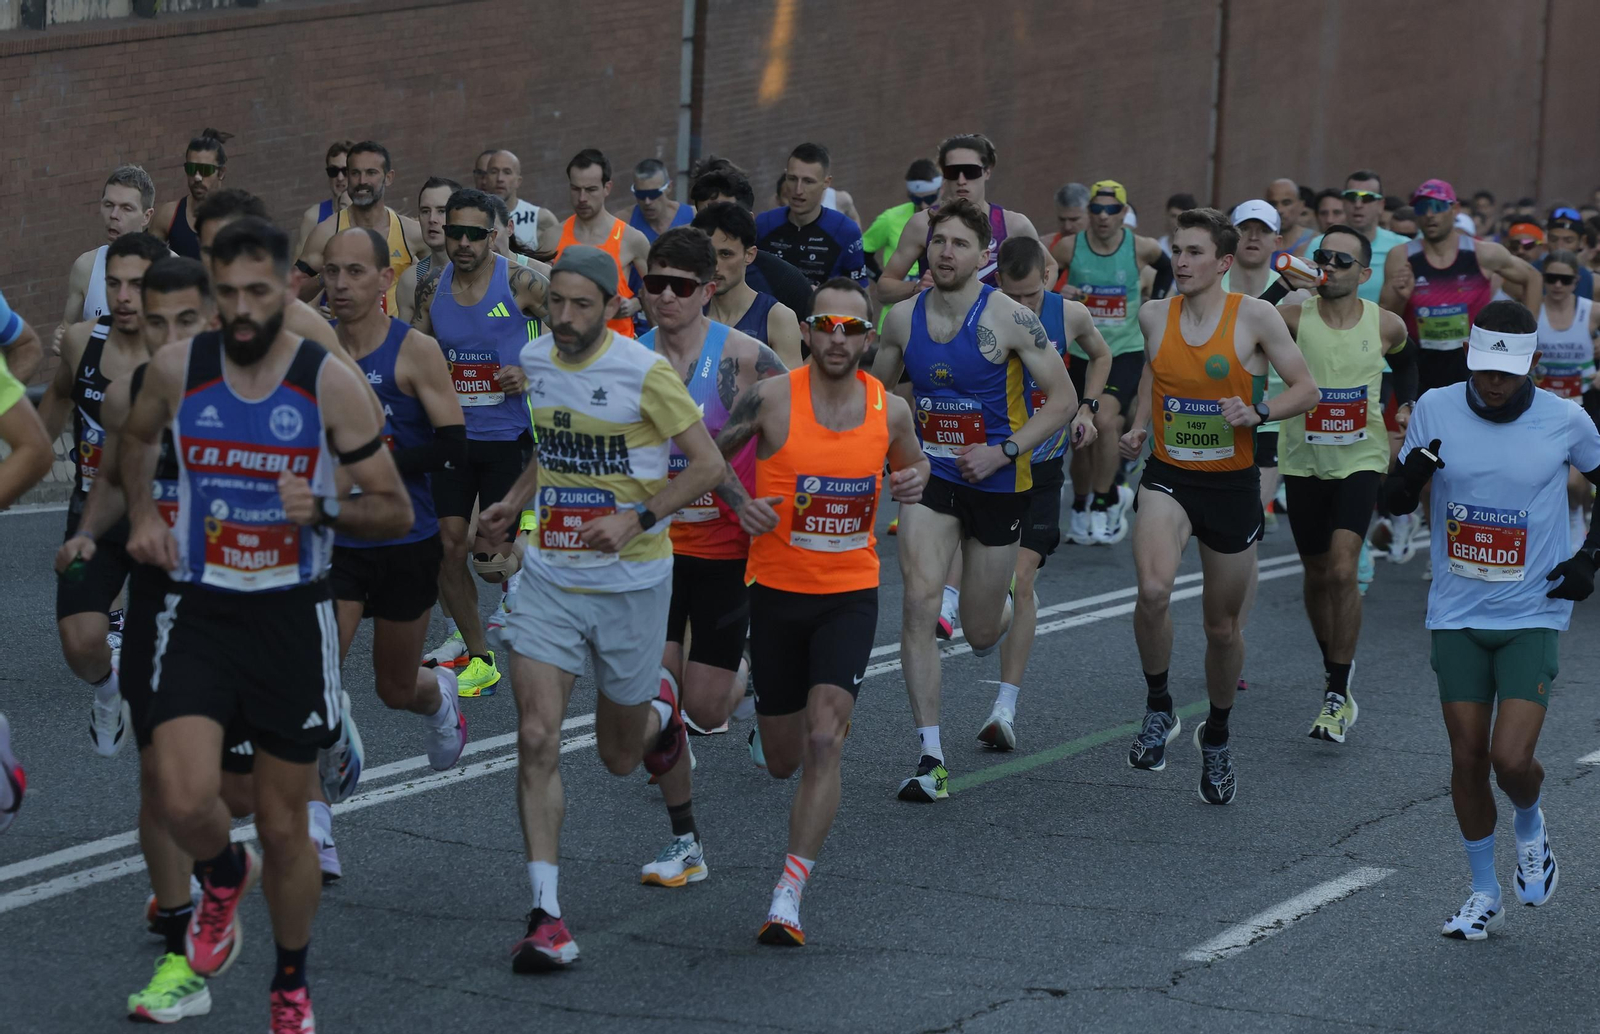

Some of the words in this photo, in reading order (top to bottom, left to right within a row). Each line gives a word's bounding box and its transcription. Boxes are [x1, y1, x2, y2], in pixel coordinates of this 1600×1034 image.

[1431, 306, 1462, 315] ZURICH
[459, 353, 492, 361] ZURICH
[463, 369, 477, 378] 692
[701, 356, 713, 379] soar
[455, 379, 492, 392] COHEN
[1326, 391, 1362, 400] ZURICH
[936, 402, 973, 411] ZURICH
[1184, 403, 1223, 412] ZURICH
[1329, 408, 1346, 417] 929
[553, 410, 571, 429] 59
[938, 419, 959, 429] 1219
[1186, 421, 1207, 430] 1497
[1321, 418, 1354, 431] RICHI
[936, 430, 965, 445] EOIN
[1176, 432, 1220, 446] SPOOR
[667, 459, 690, 468] URI
[826, 481, 870, 492] ZURICH
[559, 492, 605, 504] ZURICH
[825, 503, 849, 515] 1061
[232, 508, 286, 523] ZURICH
[563, 516, 582, 527] 866
[1472, 510, 1517, 525] ZURICH
[805, 515, 862, 534] STEVEN
[1474, 532, 1493, 544] 653
[221, 546, 280, 570] TRABU
[1452, 542, 1518, 564] GERALDO
